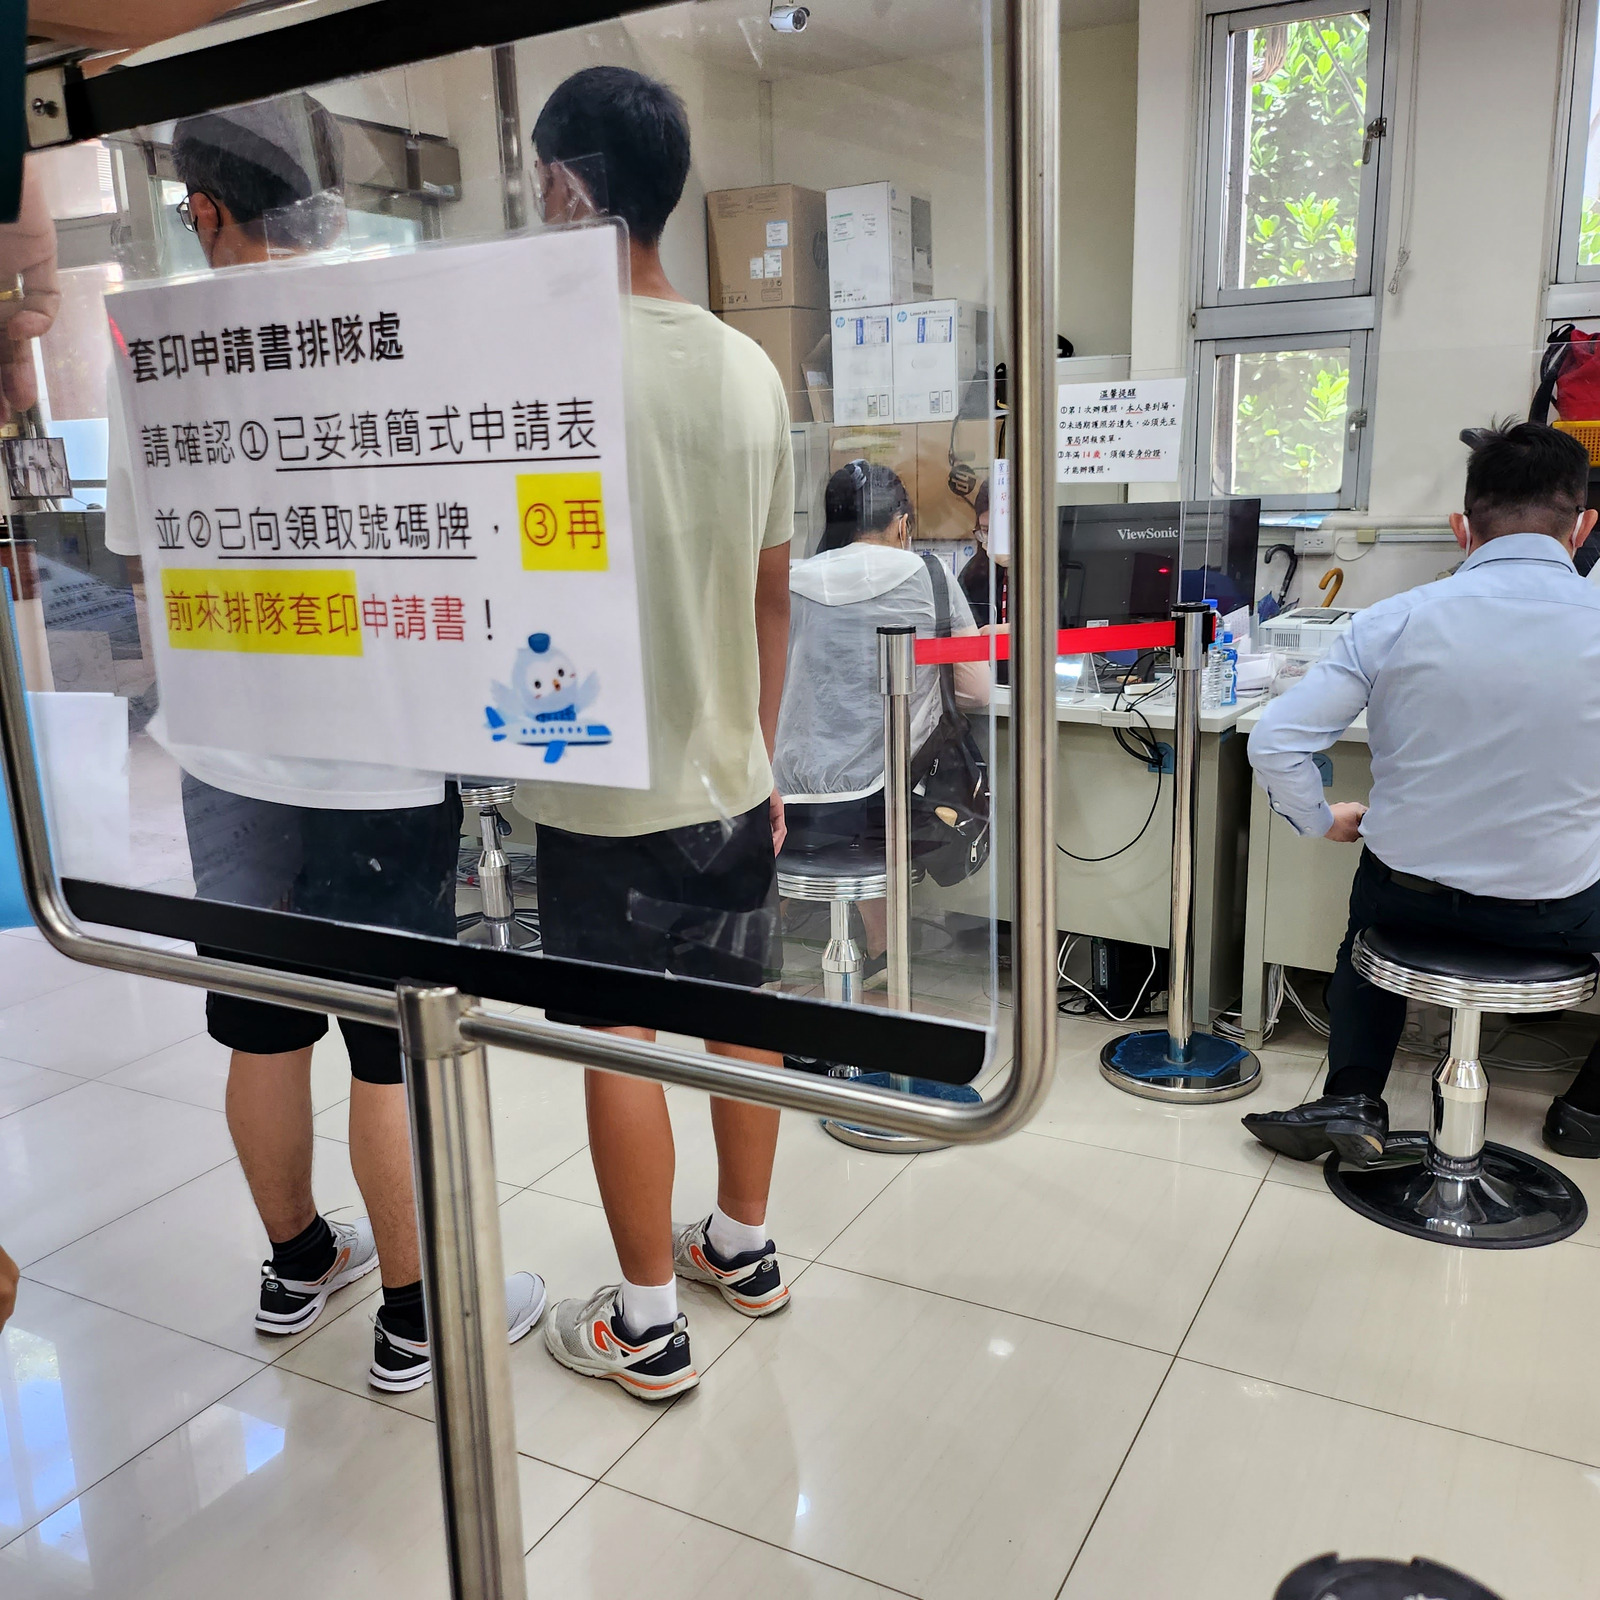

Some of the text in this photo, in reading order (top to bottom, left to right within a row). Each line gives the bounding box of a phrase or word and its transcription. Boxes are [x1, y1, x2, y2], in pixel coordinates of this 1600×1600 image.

[129, 311, 405, 383] 套印申請書排隊處
[1100, 388, 1136, 398] 溫馨提醒
[142, 397, 598, 469] 請確認①已妥填簡式申請表
[1117, 527, 1179, 540] ViewSonic
